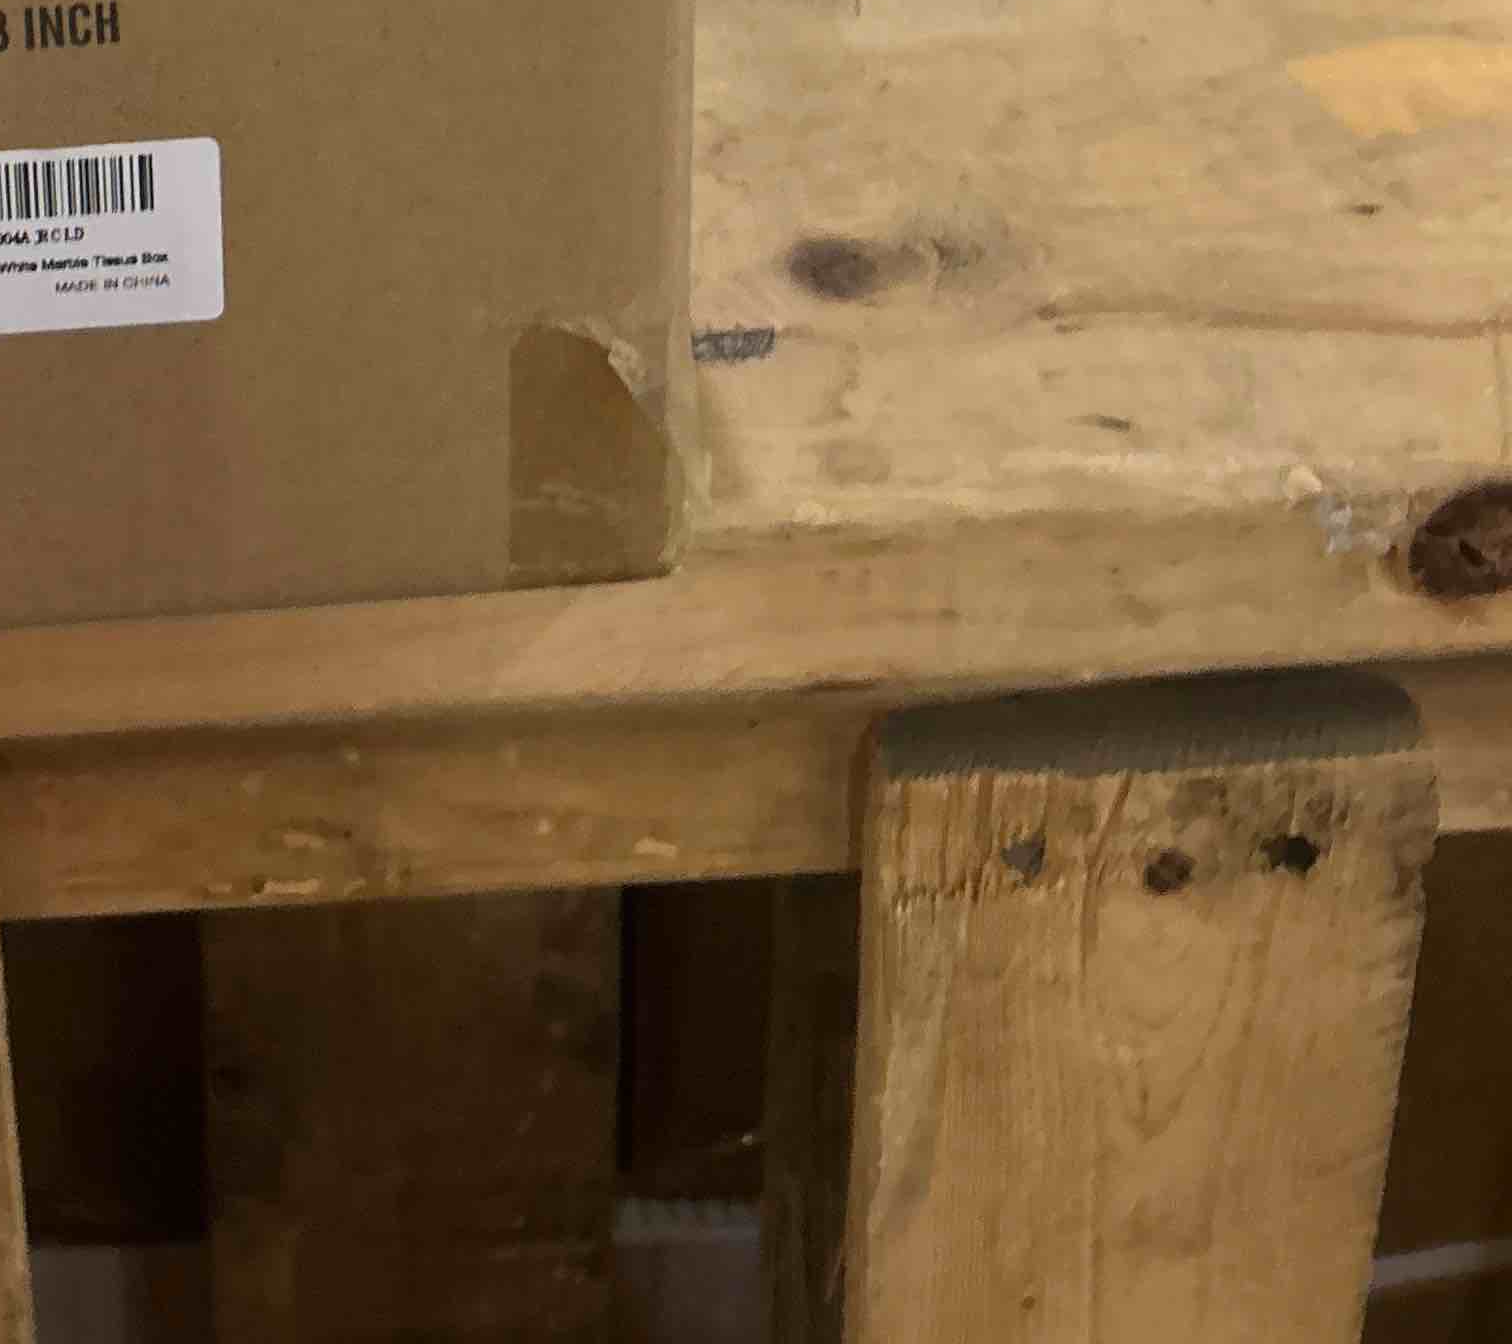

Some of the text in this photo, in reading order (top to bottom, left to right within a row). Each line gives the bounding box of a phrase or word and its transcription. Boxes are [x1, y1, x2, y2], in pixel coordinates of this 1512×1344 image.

[24, 1, 121, 52] INCH
[41, 257, 88, 272] Marble
[93, 253, 138, 269] Tissue
[142, 251, 169, 266] Box
[55, 272, 170, 295] MADE IN CHINA
